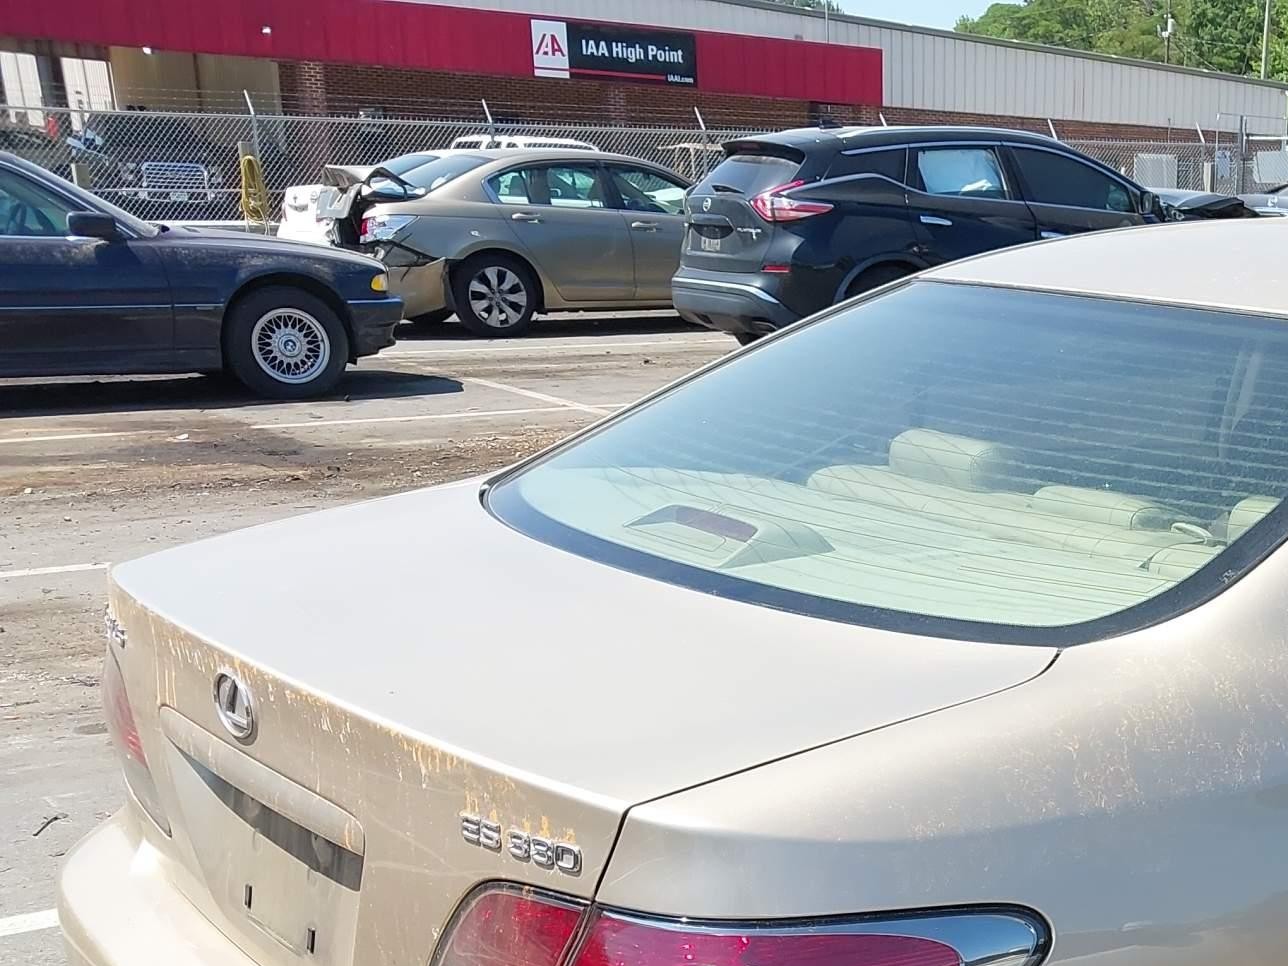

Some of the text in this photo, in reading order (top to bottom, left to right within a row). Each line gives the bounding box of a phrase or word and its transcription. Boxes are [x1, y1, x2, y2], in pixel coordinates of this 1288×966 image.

[581, 39, 684, 64] IAA High Point
[507, 830, 583, 877] 330
